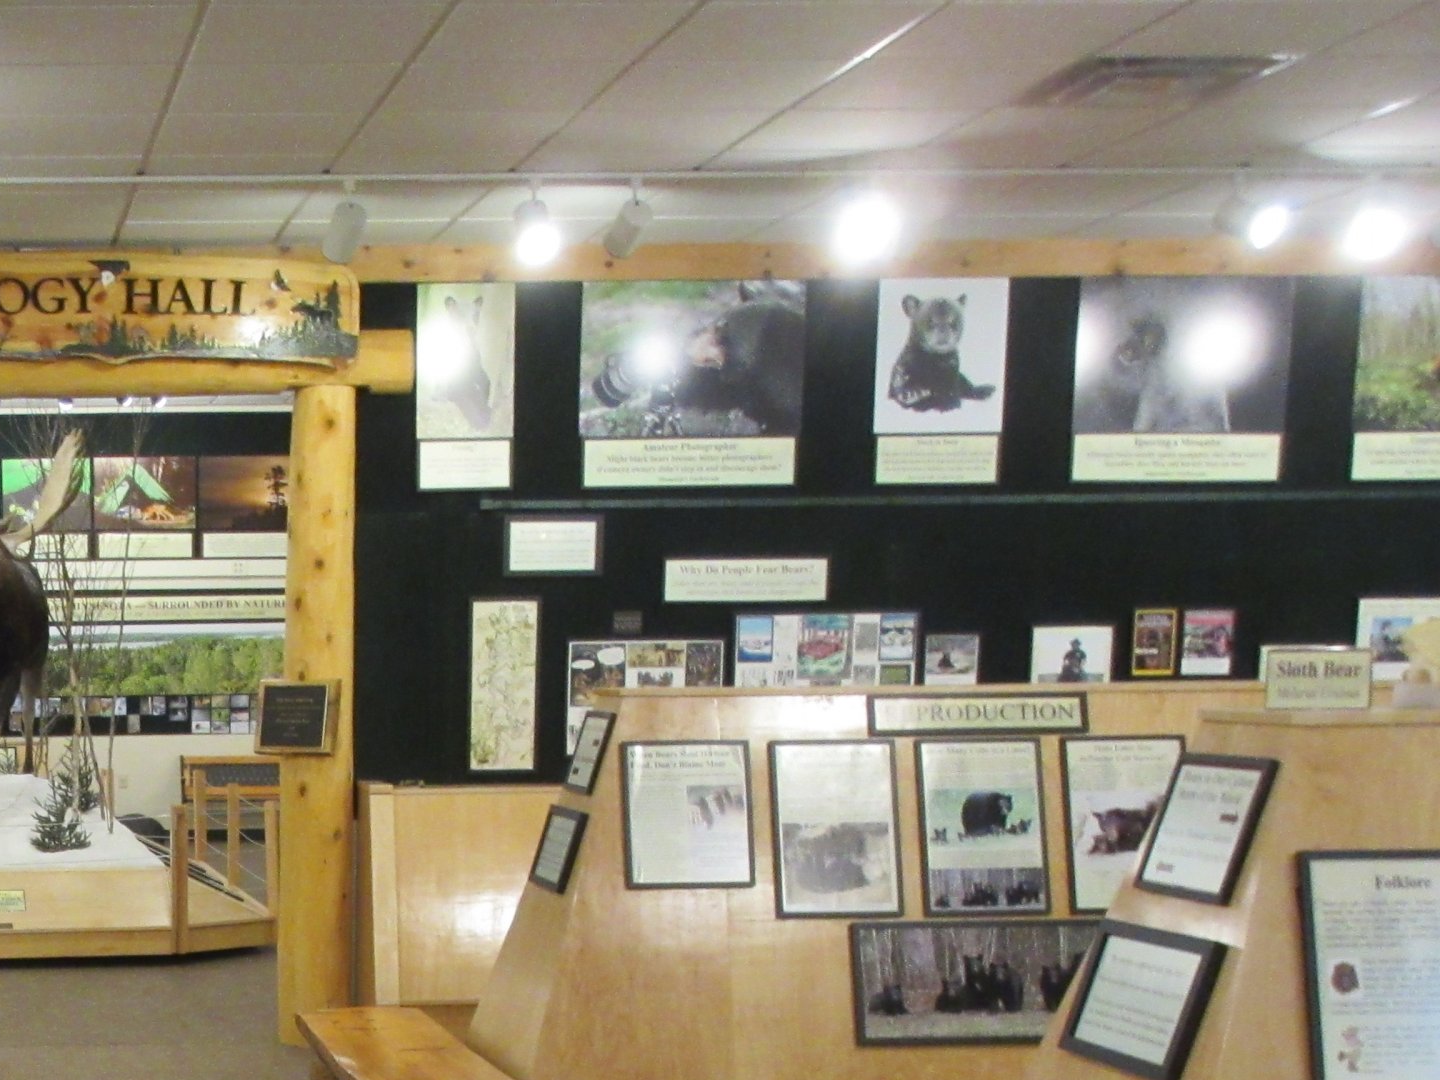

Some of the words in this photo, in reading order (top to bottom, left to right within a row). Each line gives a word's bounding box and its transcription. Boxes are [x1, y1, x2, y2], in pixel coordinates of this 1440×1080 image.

[122, 276, 255, 317] HALL
[1277, 660, 1318, 678] Sloth
[1323, 660, 1362, 677] Bear
[885, 703, 1074, 722] PRODUCTION
[1374, 875, 1432, 890] Folklore
